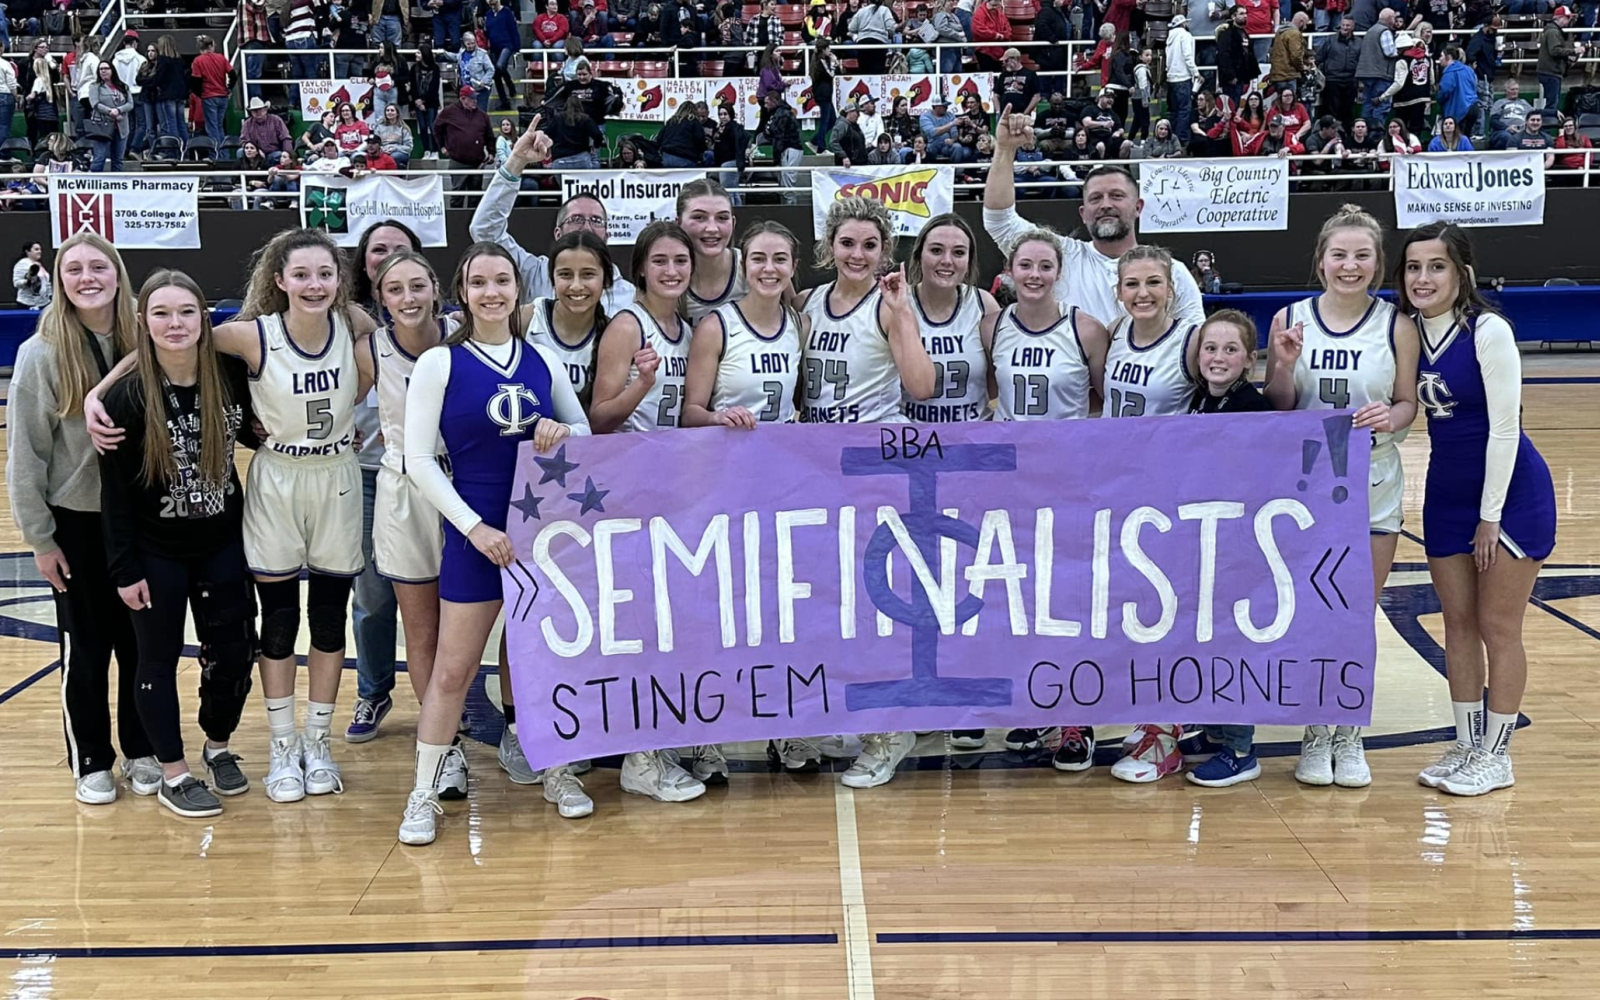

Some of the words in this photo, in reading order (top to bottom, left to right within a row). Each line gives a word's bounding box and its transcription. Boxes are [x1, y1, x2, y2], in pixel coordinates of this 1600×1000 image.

[300, 80, 333, 88] TAYLOR
[886, 75, 912, 83] DEJAH
[302, 87, 330, 95] OQUIN
[57, 179, 128, 190] McWilliams
[132, 180, 194, 193] Pharmacy
[1200, 166, 1224, 186] Big
[1226, 166, 1282, 185] Country
[1406, 162, 1474, 190] Edward
[1476, 162, 1533, 192] Jones
[564, 179, 615, 200] Tindol
[620, 178, 682, 200] Insuran
[840, 180, 928, 205] SONIC
[1210, 185, 1270, 205] Electric
[115, 210, 138, 218] 3706
[140, 210, 176, 219] College
[178, 210, 195, 218] Ave
[349, 201, 377, 217] Cogdell
[413, 202, 443, 219] Hospital
[1196, 205, 1279, 228] Cooperative
[1407, 203, 1441, 213] MAKING
[1443, 202, 1471, 212] SENSE
[1474, 202, 1485, 211] OF
[1488, 200, 1532, 211] INVESTING
[124, 221, 187, 229] 325-573-7582
[810, 330, 850, 352] LADY
[924, 335, 964, 354] LADY
[664, 356, 688, 377] LAD
[751, 353, 789, 373] LADY
[1011, 348, 1055, 367] LADY
[1310, 349, 1362, 370] LADY
[293, 367, 340, 394] LADY
[806, 358, 849, 400] 34
[1111, 360, 1155, 387] LADY
[760, 381, 783, 421] 3
[1013, 374, 1049, 416] 13
[1319, 378, 1350, 409] 4
[306, 398, 333, 439] 5
[906, 402, 979, 422] HORNETS
[880, 428, 943, 461] BBA
[532, 498, 1316, 658] SEMIFINALISTS
[1027, 660, 1104, 710] GO
[1130, 656, 1365, 710] HORNETS
